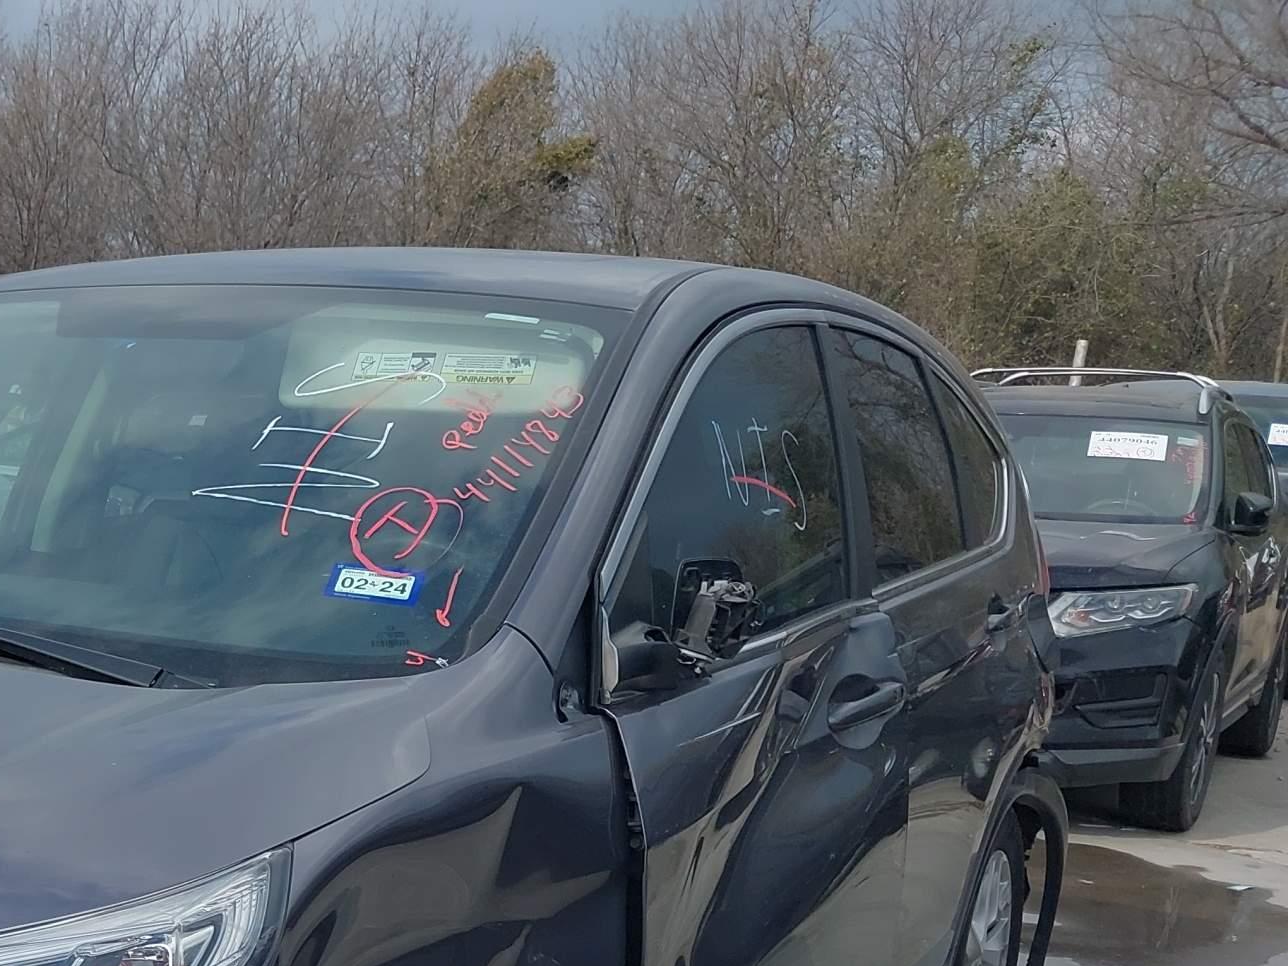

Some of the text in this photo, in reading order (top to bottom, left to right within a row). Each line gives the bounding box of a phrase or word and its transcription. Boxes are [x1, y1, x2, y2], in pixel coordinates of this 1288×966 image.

[456, 375, 505, 385] WARNING
[340, 576, 408, 595] 02 24
